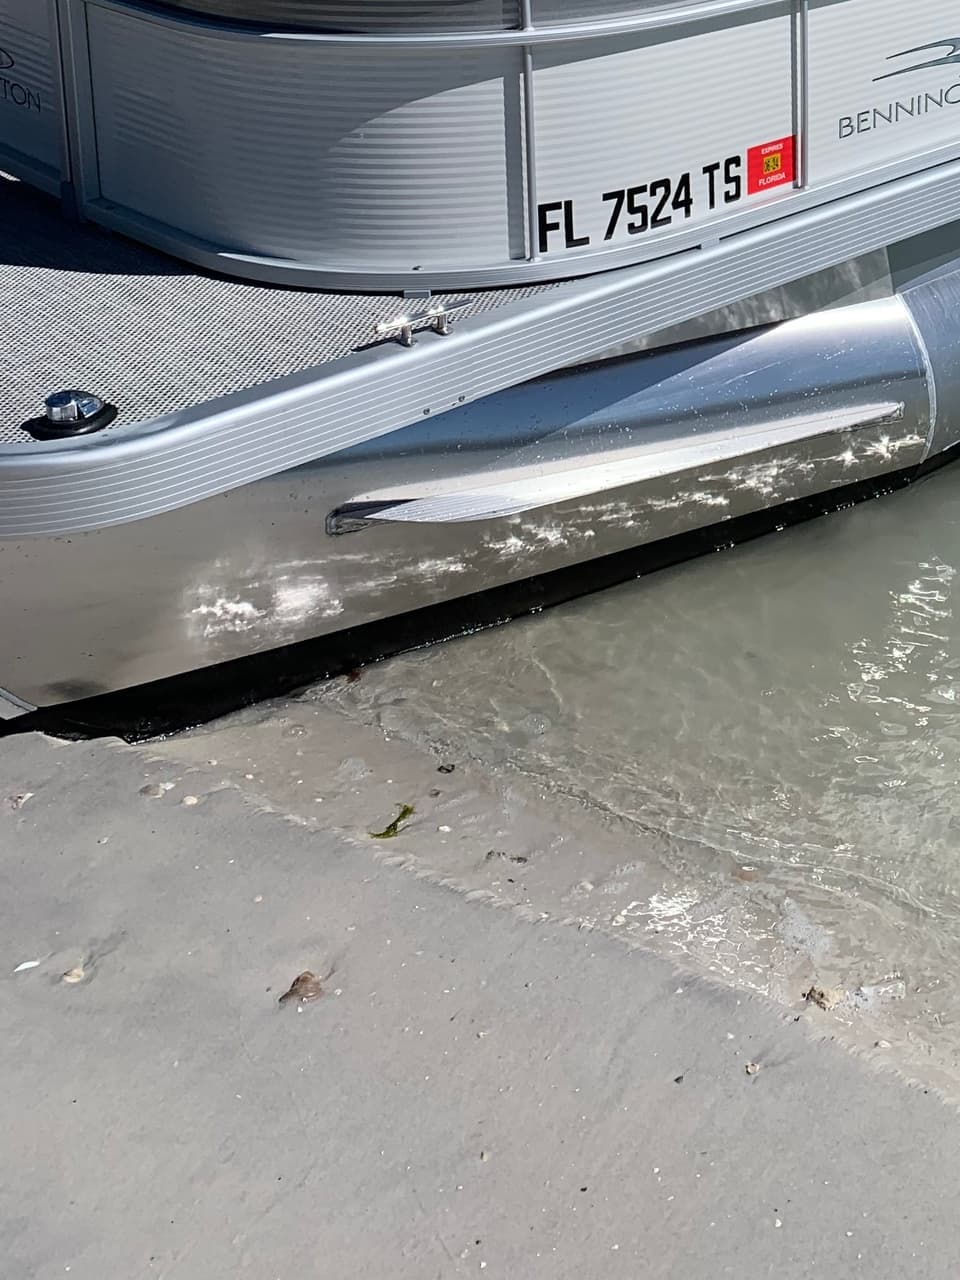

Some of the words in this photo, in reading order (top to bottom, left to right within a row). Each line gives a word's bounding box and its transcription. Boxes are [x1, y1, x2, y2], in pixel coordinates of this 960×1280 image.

[537, 199, 590, 253] FL
[602, 172, 693, 240] 7524
[702, 155, 741, 210] TS
[758, 172, 786, 187] FLORIDA
